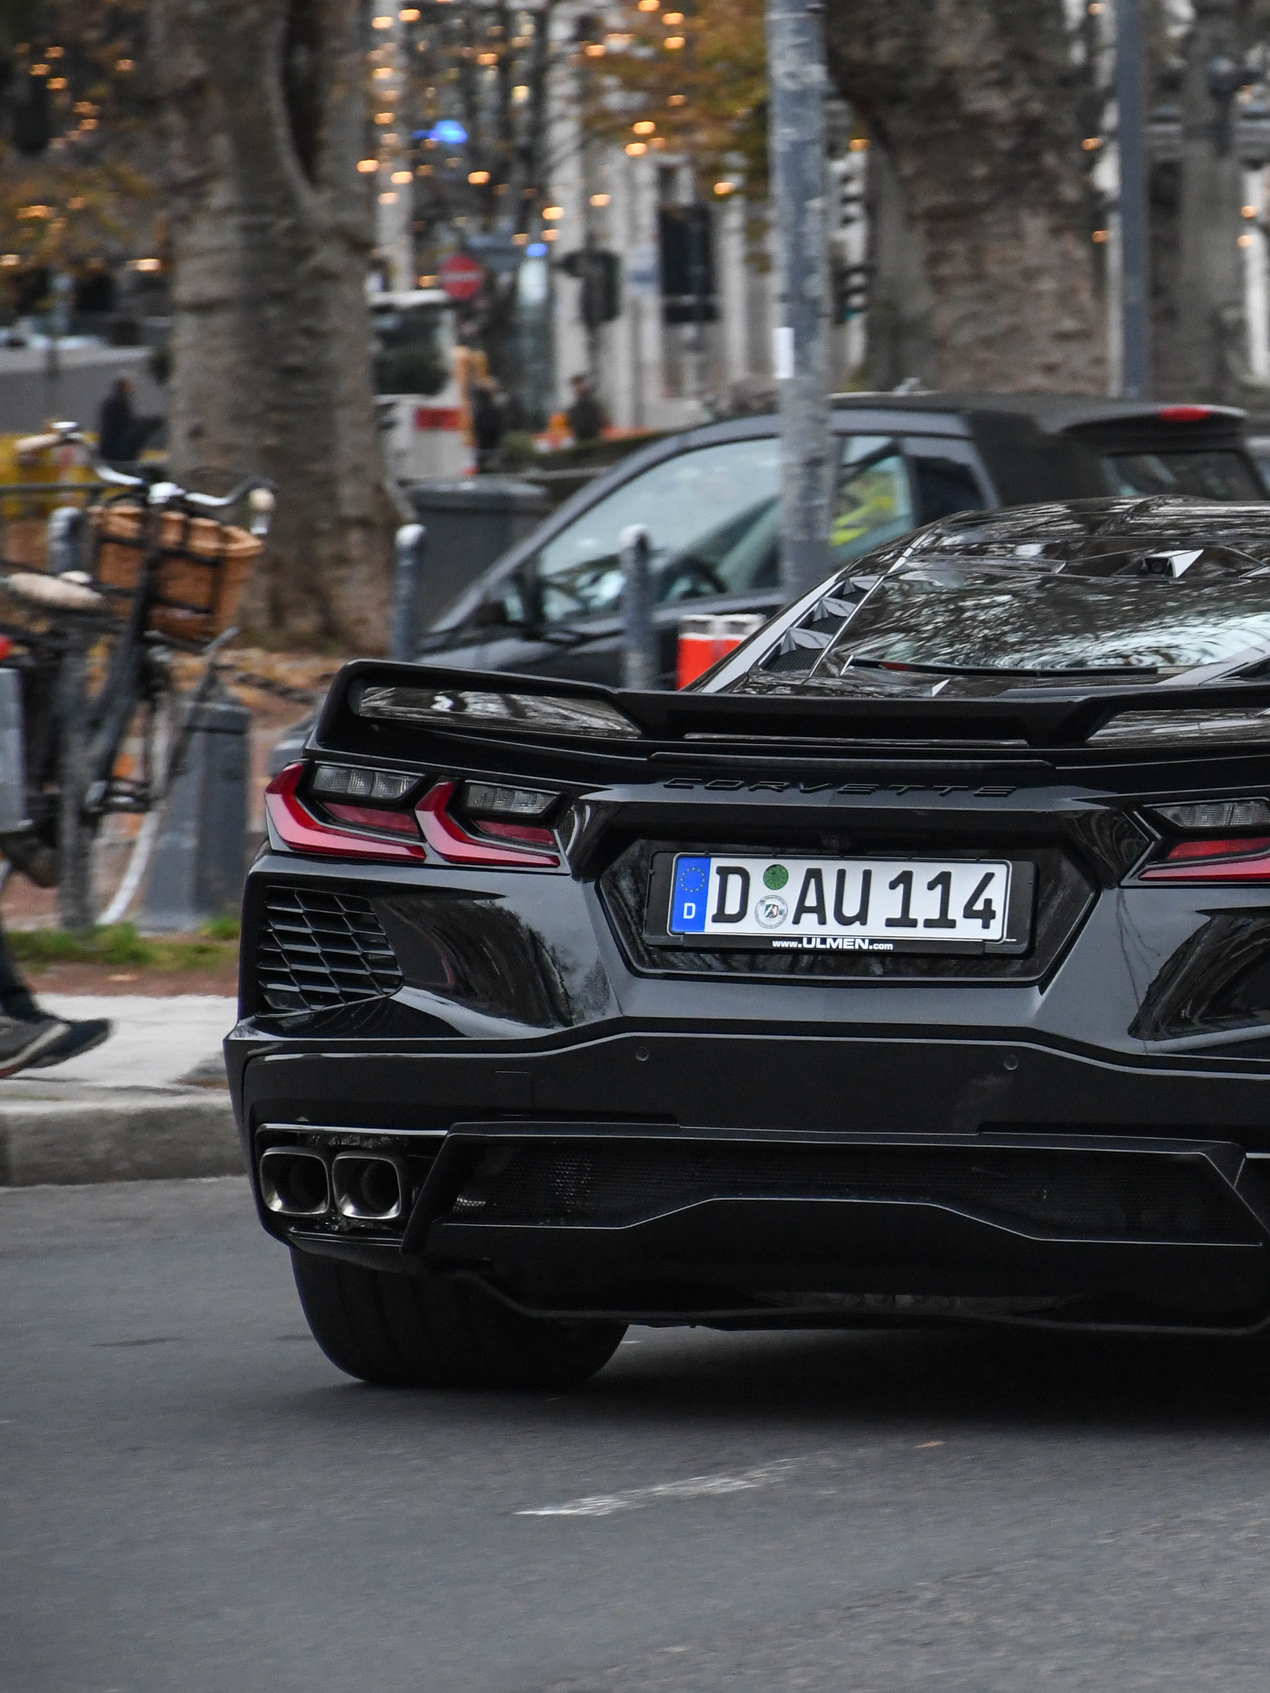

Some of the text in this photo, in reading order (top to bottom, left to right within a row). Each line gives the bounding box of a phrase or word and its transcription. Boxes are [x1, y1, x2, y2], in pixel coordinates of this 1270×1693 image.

[663, 777, 1018, 798] CORVETTE
[711, 866, 750, 924] D
[791, 868, 873, 926] AU
[884, 870, 997, 929] 114
[683, 903, 696, 920] D
[772, 936, 893, 951] www.ULMEN.com
